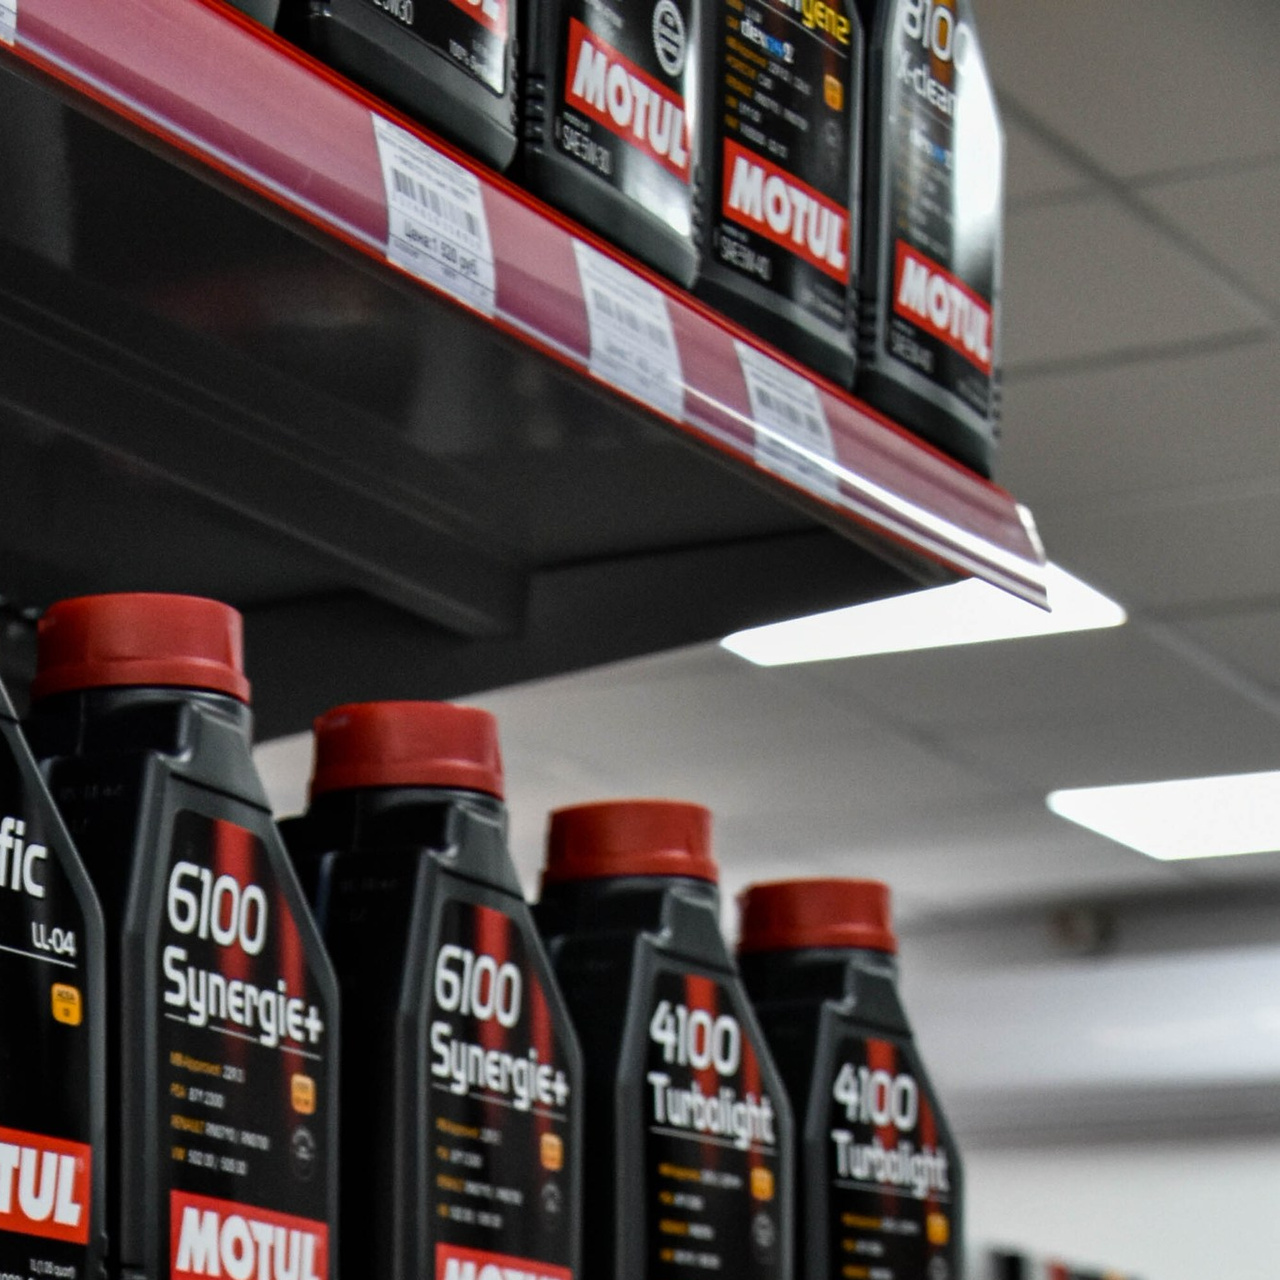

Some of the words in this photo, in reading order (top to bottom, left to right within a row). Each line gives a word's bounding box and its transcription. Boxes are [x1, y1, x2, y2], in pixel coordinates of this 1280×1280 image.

[572, 40, 687, 169] MOTUL
[729, 156, 844, 270] MOTUL
[900, 256, 989, 364] MOTUL
[32, 922, 76, 956] LL-04
[167, 861, 267, 955] 6100
[163, 945, 324, 1048] Synergie+
[434, 943, 520, 1028] 6100
[431, 1022, 569, 1111] Synergie+
[650, 1000, 740, 1077] 4100
[648, 1071, 774, 1149] Turbolight
[833, 1063, 917, 1131] 4100
[831, 1130, 950, 1198] Turbolight
